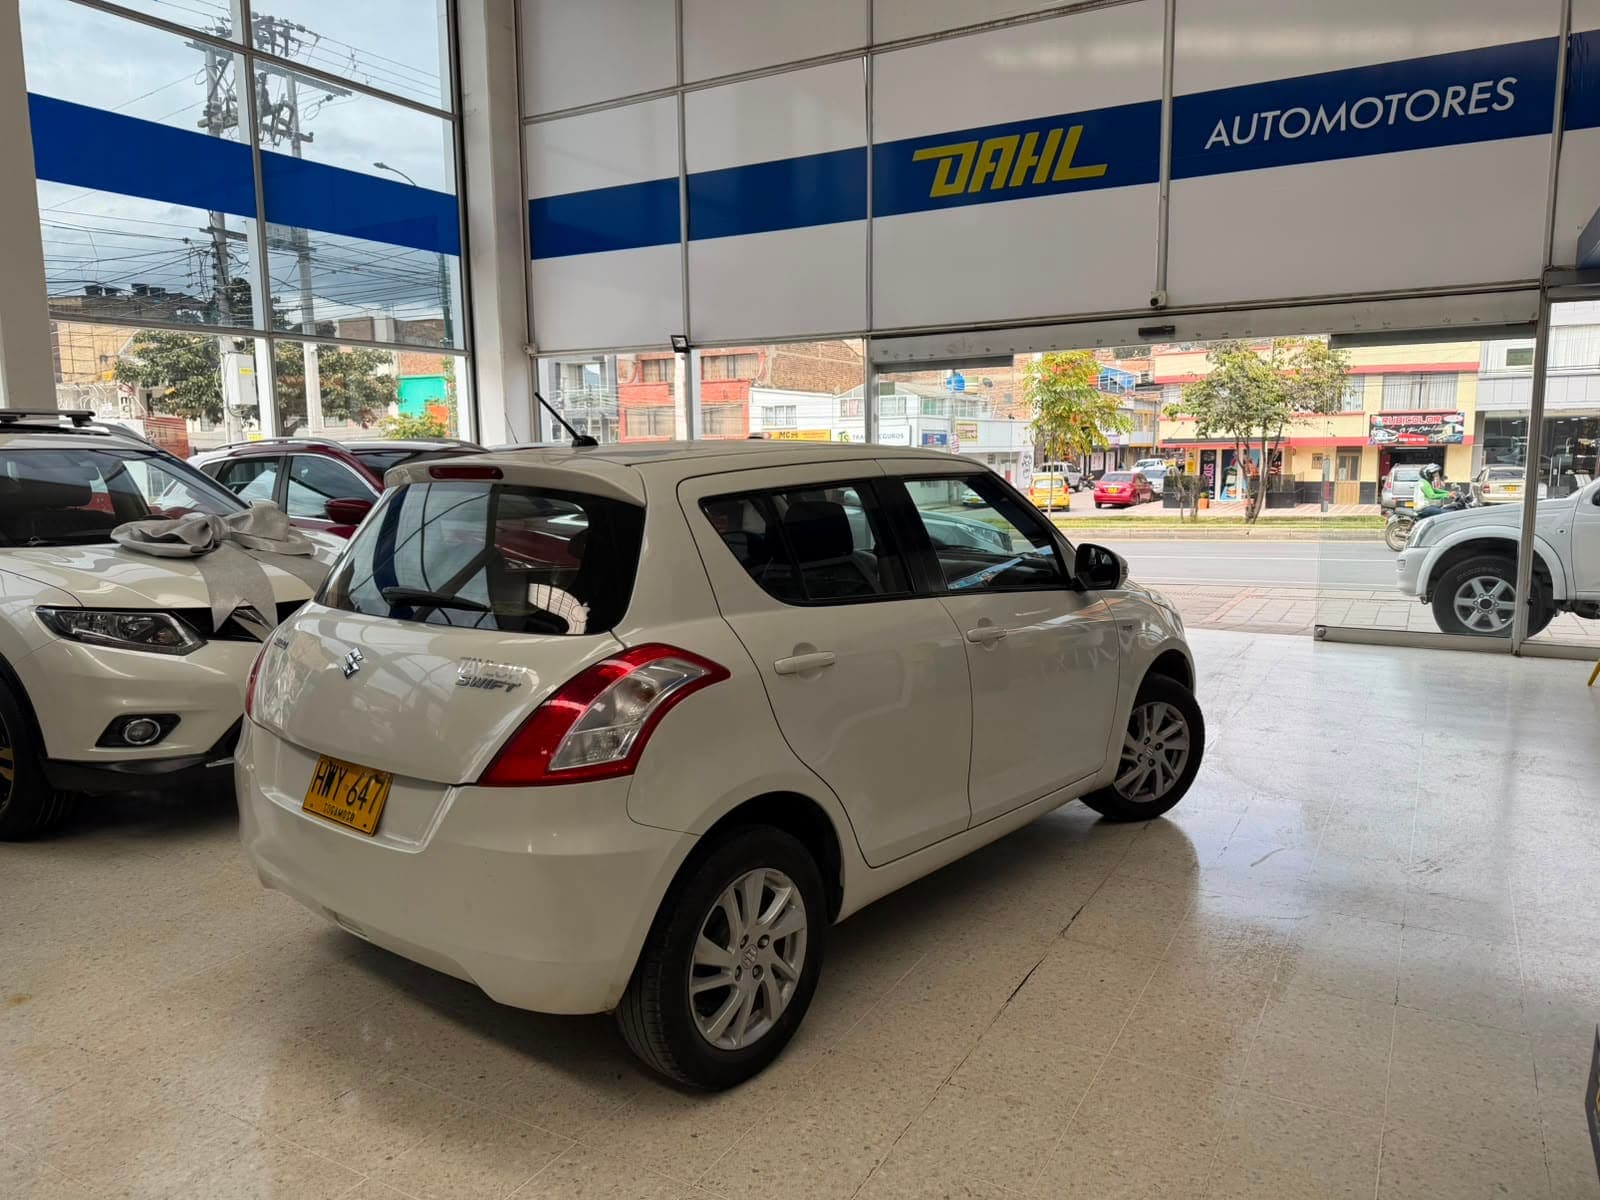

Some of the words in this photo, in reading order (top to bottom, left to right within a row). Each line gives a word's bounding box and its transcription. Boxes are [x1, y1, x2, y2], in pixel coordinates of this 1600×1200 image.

[1205, 76, 1518, 150] AUTOMOTORES
[912, 125, 1108, 199] DAHL
[455, 676, 522, 693] SWIFT
[310, 761, 349, 802] HWY
[346, 771, 384, 815] 647
